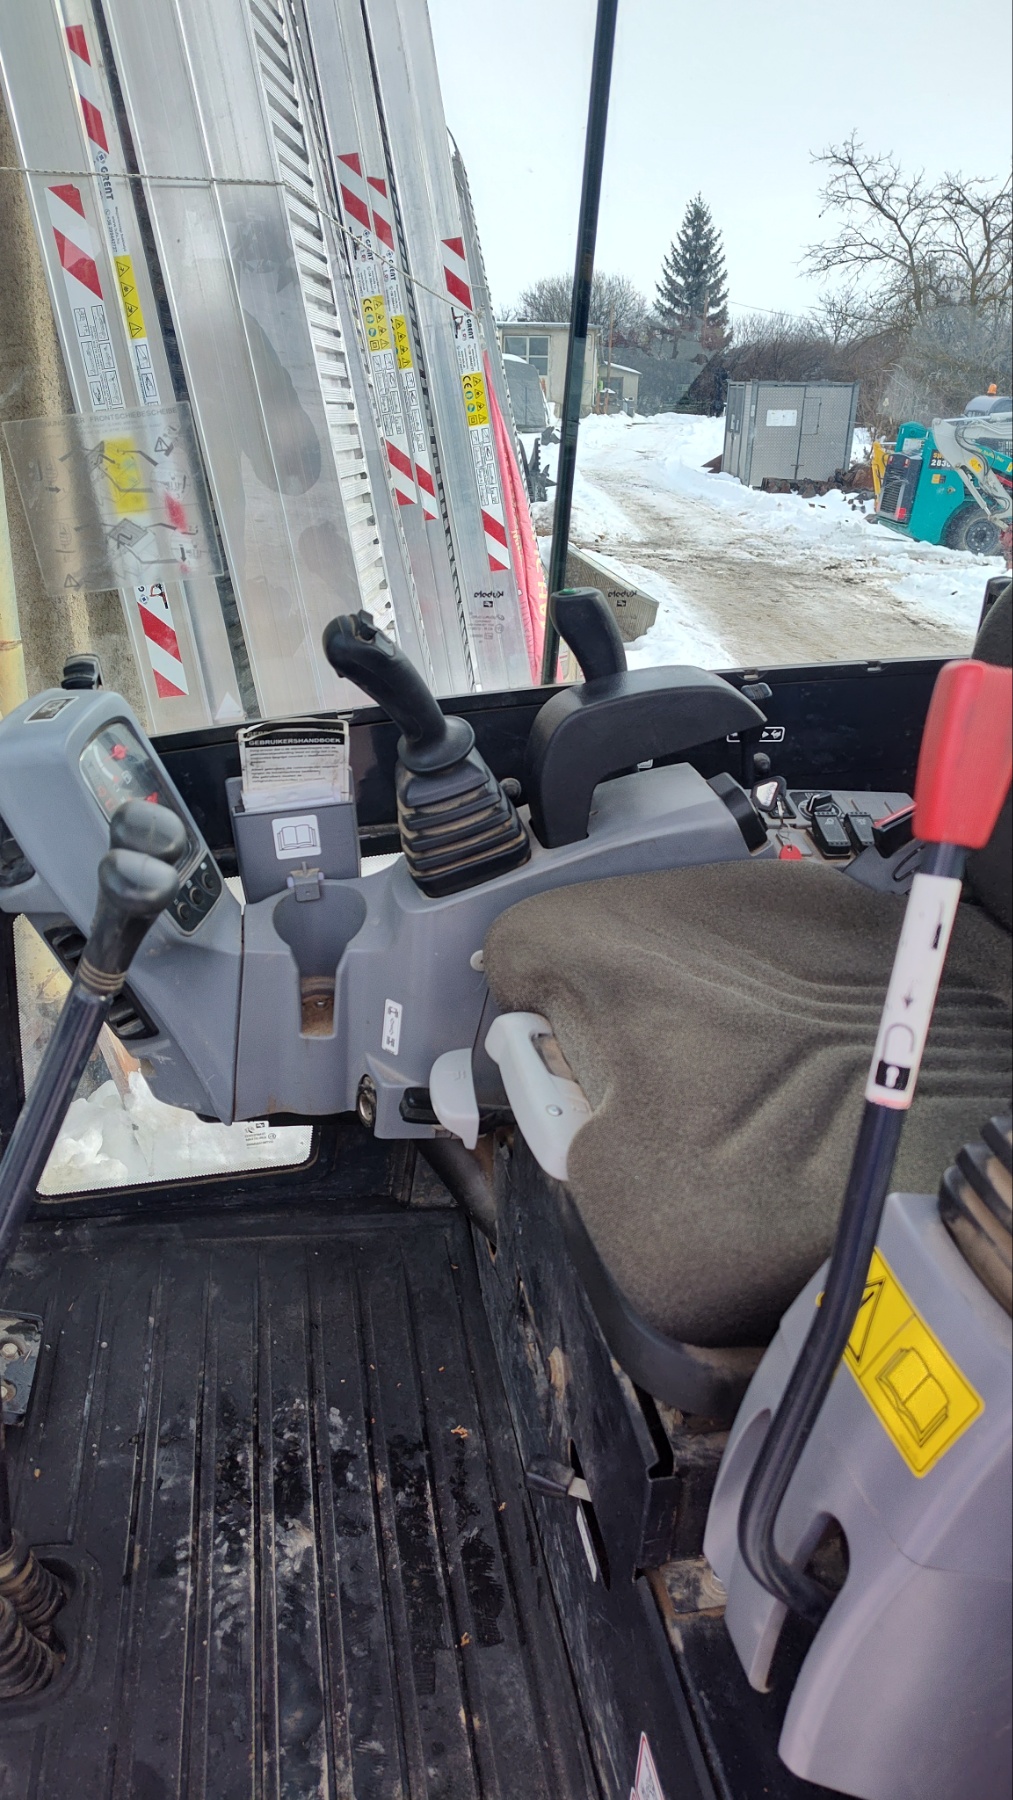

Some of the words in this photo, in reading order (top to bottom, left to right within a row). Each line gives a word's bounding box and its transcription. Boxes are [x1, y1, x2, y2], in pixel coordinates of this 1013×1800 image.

[365, 239, 374, 261] GRNT
[388, 259, 397, 281] GENT
[248, 738, 342, 746] GEBRUIKERSHANDBOEK
